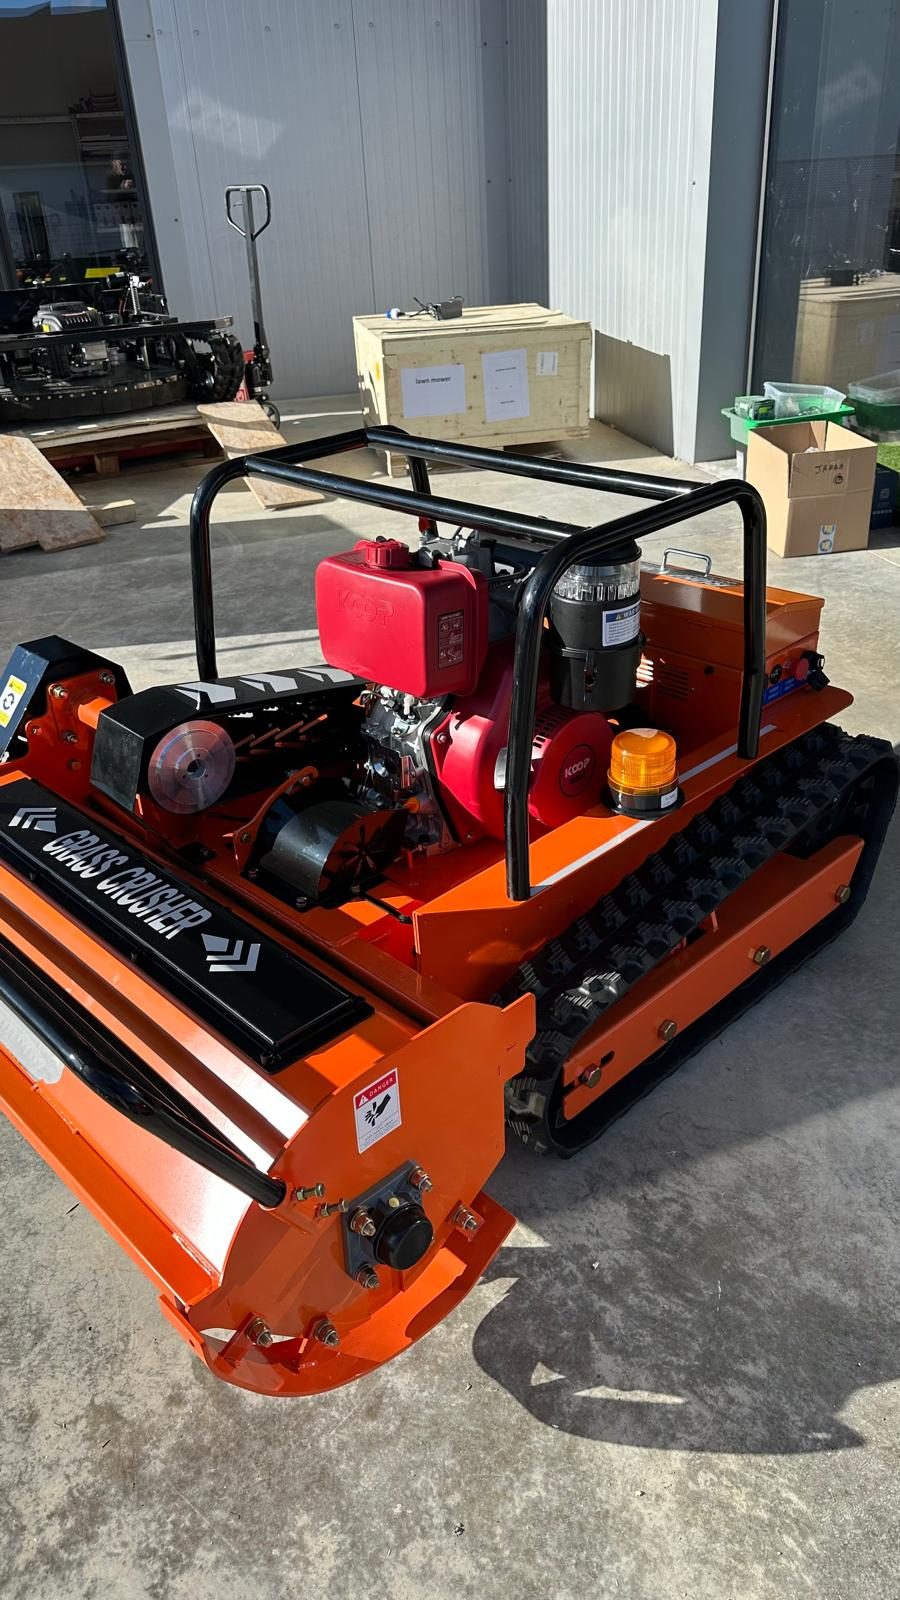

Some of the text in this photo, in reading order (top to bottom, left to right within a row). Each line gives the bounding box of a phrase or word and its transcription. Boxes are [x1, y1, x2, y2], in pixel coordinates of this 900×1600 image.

[564, 757, 590, 779] KOOP
[42, 829, 212, 940] GRASS CRUSHER
[369, 1078, 393, 1097] DANGER
